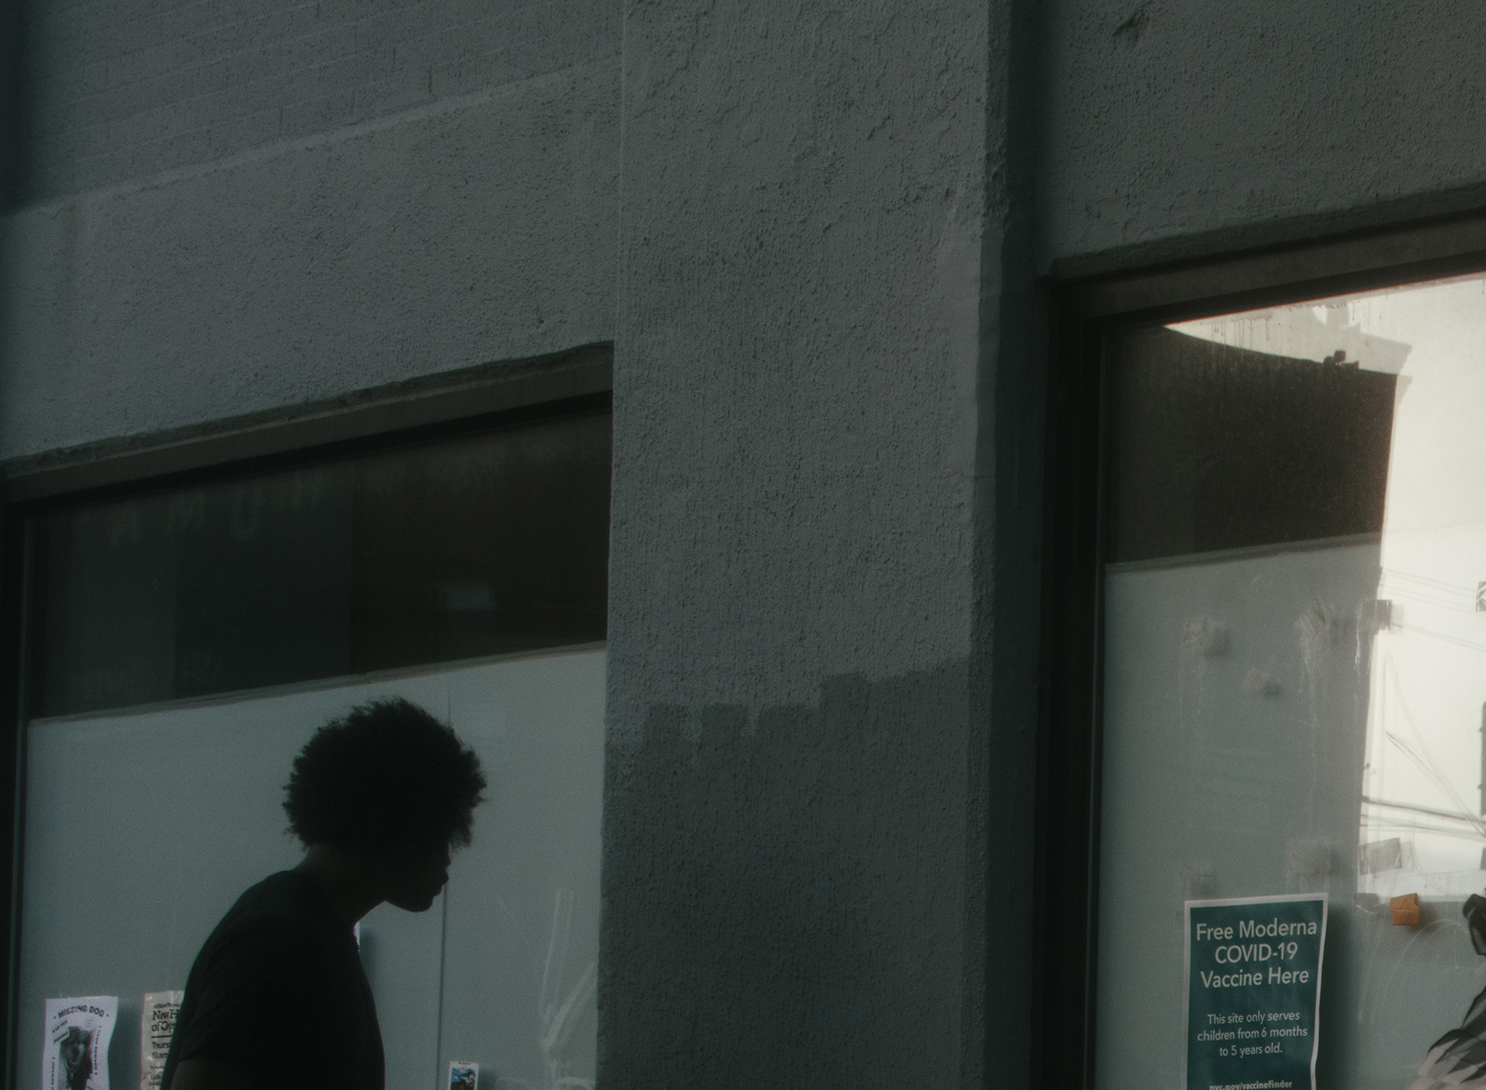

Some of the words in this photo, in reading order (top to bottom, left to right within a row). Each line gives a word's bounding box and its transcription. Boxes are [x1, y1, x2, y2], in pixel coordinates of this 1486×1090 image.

[1196, 923, 1233, 941] Free
[1239, 918, 1317, 938] Moderna
[1215, 942, 1298, 964] COVID-19
[1200, 969, 1262, 988] Vaccine
[1268, 967, 1309, 984] Here
[58, 1005, 88, 1018] MISSING
[89, 1006, 104, 1017] DOG
[1207, 1014, 1225, 1024] This
[1228, 1013, 1244, 1024] site
[1246, 1010, 1265, 1024] only
[1268, 1012, 1300, 1022] serves
[1197, 1030, 1235, 1041] children
[1237, 1028, 1259, 1039] from
[1261, 1027, 1266, 1038] 6
[1270, 1025, 1308, 1037] months
[1219, 1047, 1228, 1056] to
[1231, 1045, 1237, 1056] 5
[1240, 1046, 1262, 1058] years
[1264, 1042, 1282, 1053] old.
